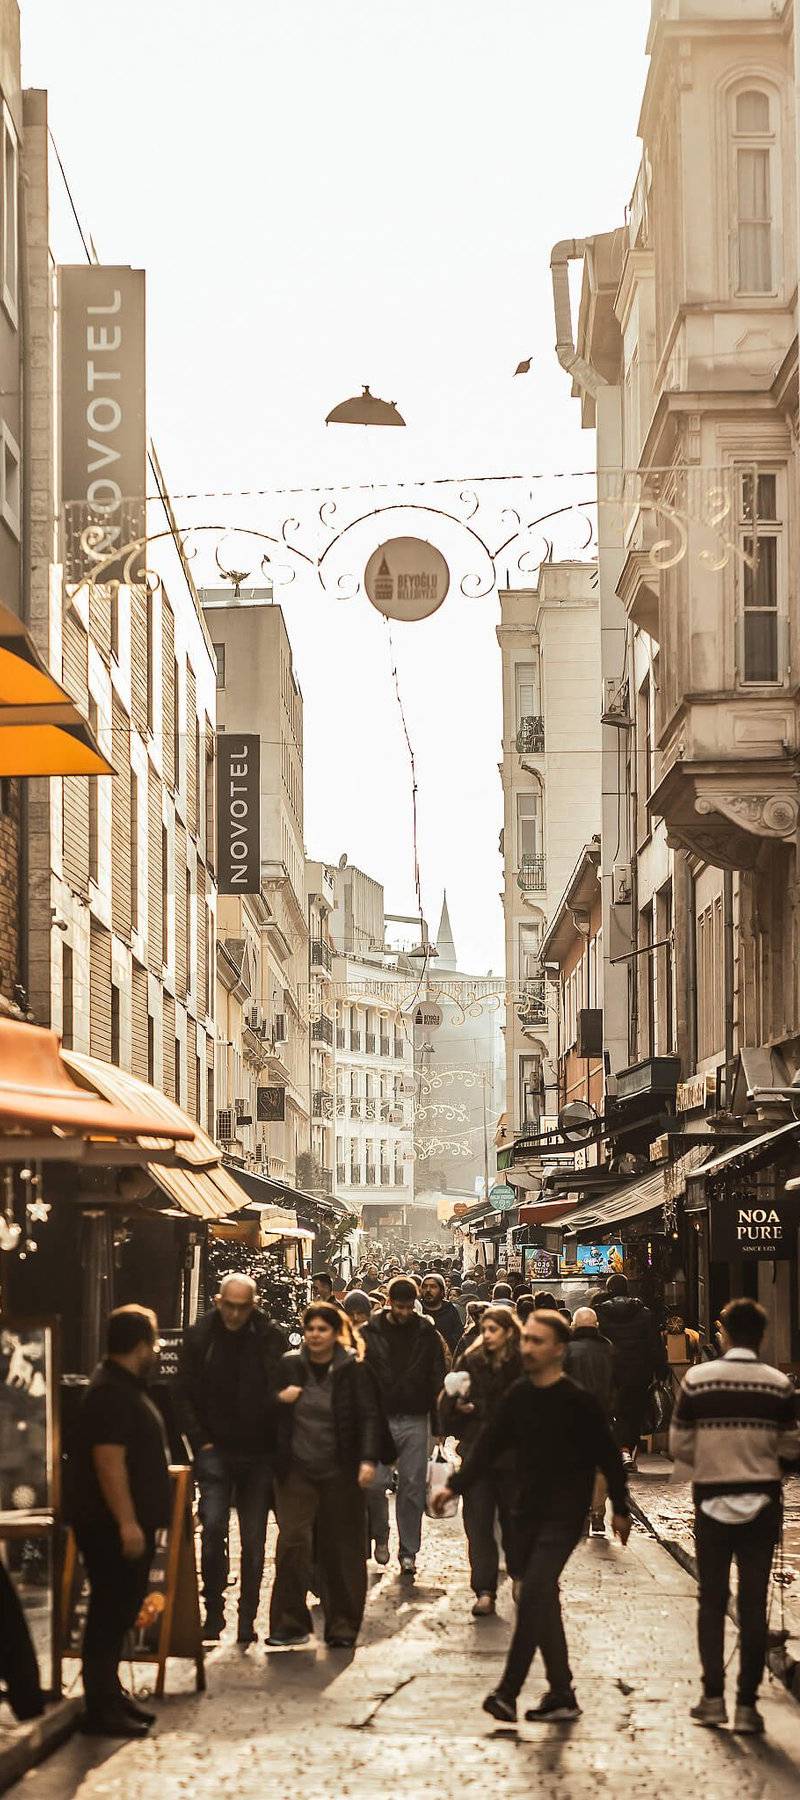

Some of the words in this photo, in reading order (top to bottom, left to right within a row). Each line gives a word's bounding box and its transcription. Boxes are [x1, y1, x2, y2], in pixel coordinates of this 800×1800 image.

[230, 745, 248, 883] NOVOTEL
[738, 1209, 780, 1223] NOA
[736, 1226, 783, 1240] PURE
